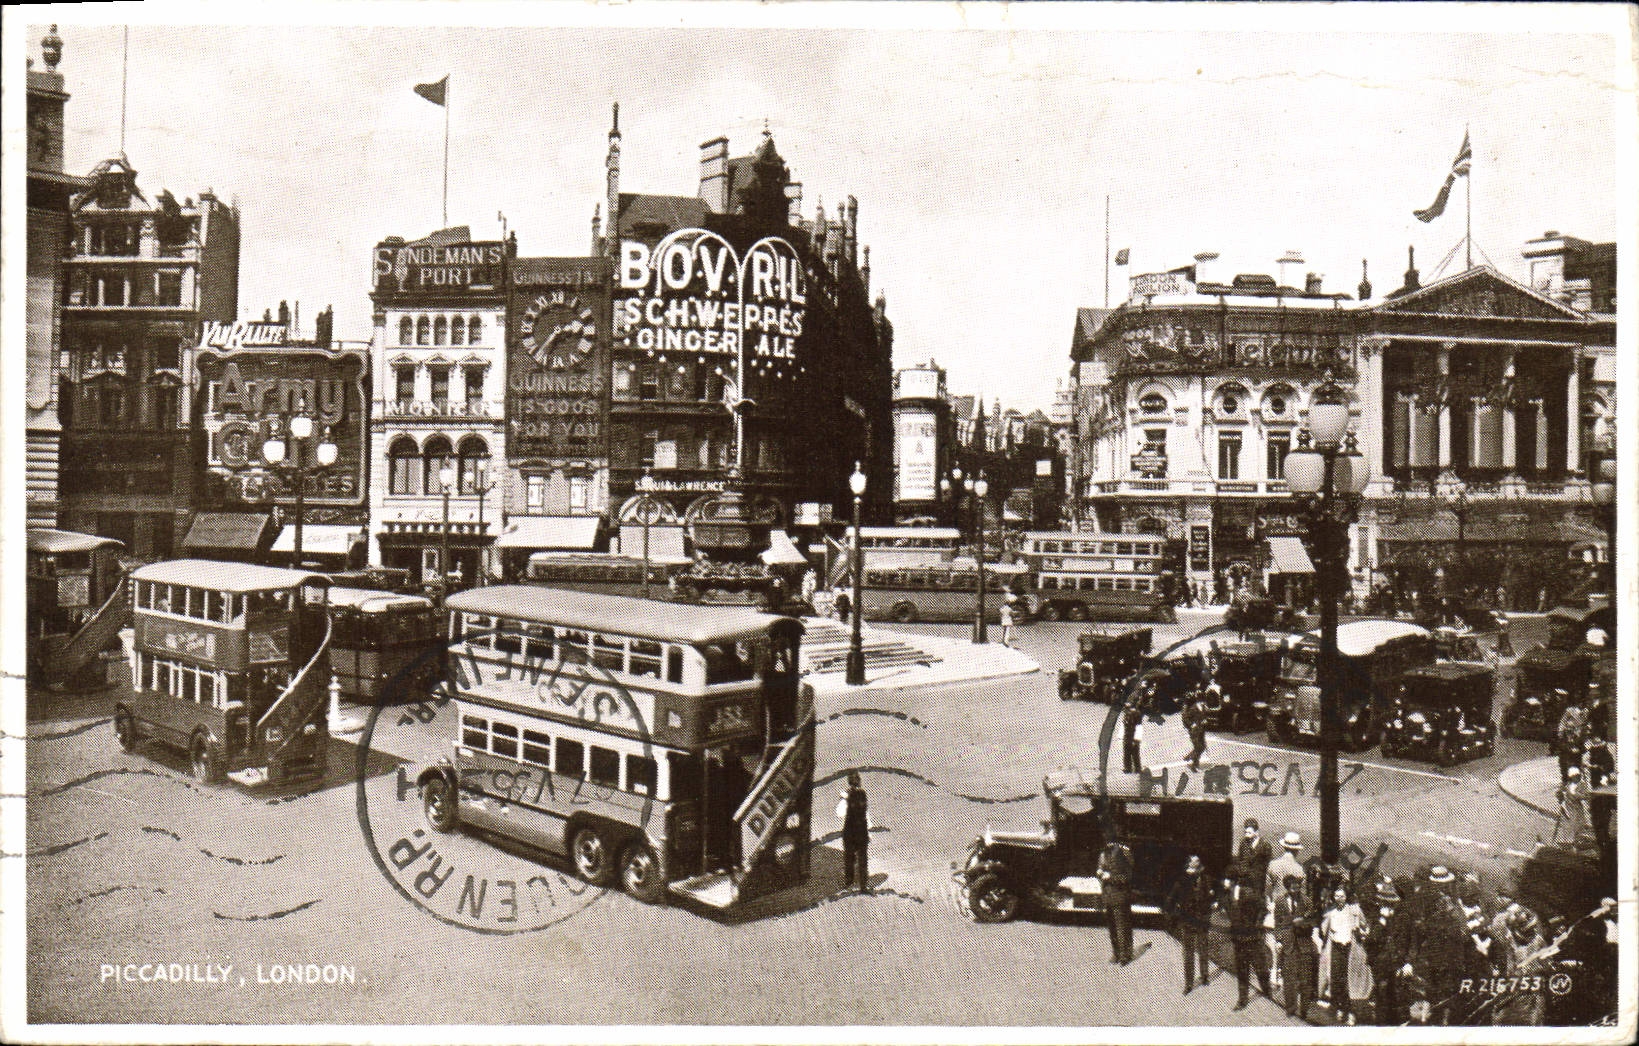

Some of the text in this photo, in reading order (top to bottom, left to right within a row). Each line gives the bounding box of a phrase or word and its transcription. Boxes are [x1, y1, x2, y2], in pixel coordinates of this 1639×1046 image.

[420, 267, 473, 286] PORT
[620, 240, 806, 304] BOVRIL
[624, 298, 804, 337] SCHWEPPES
[636, 328, 796, 358] GINGER ALE
[220, 363, 344, 424] Army
[509, 373, 604, 392] GUINNESS
[562, 422, 600, 437] YOU
